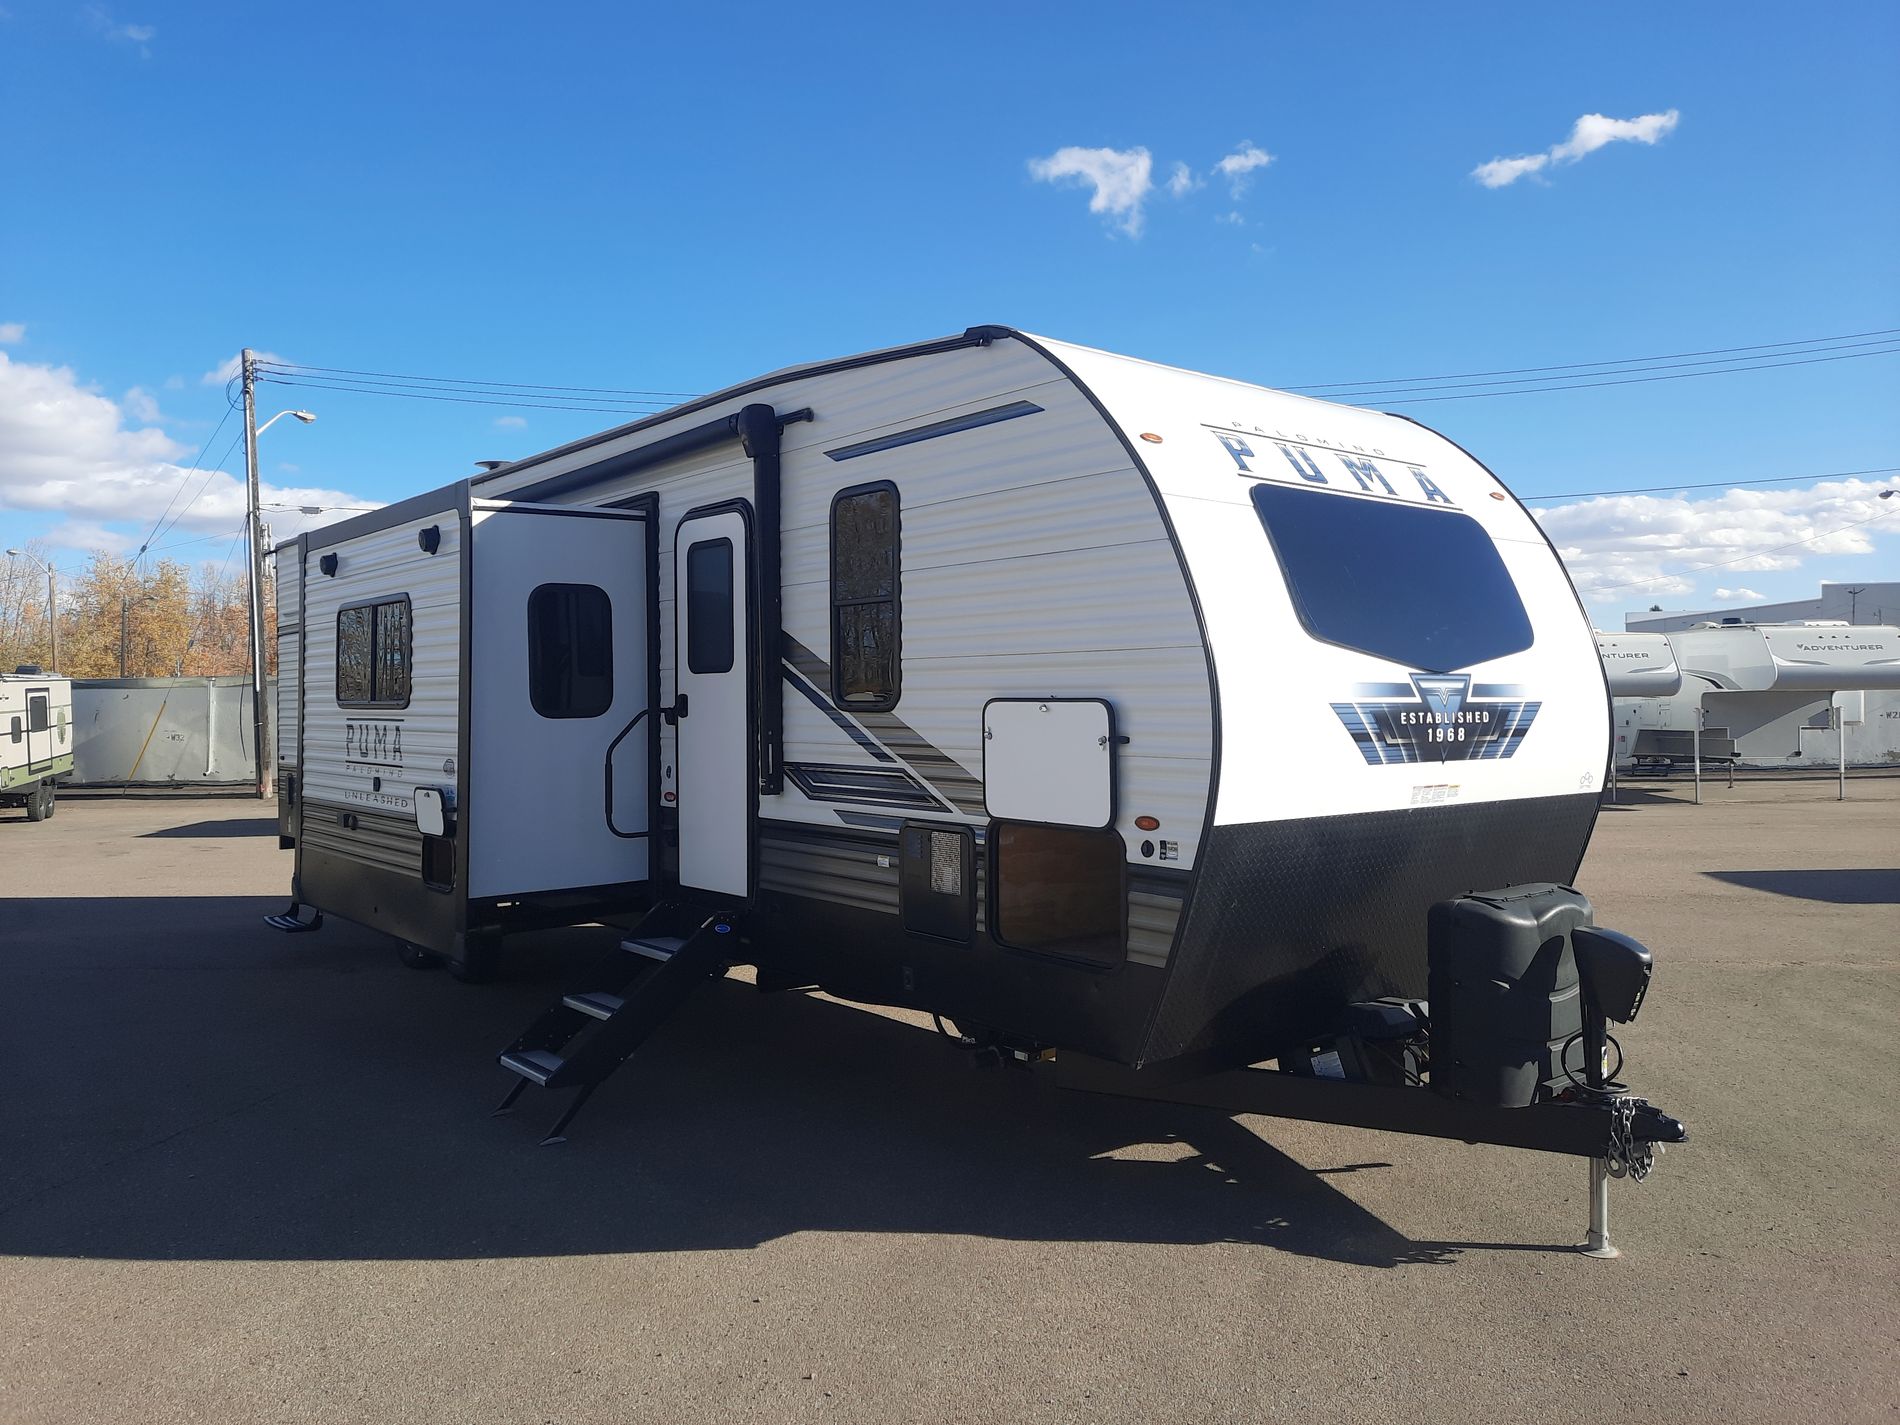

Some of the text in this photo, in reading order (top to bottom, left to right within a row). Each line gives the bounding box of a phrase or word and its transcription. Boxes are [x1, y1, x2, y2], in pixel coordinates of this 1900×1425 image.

[1232, 421, 1385, 455] PALOMINO
[1211, 429, 1456, 505] PUMA
[1401, 711, 1490, 725] ESTABLISHED
[346, 724, 403, 761] PUMA
[1427, 727, 1466, 742] 1968
[344, 791, 408, 808] UNLEASHED
